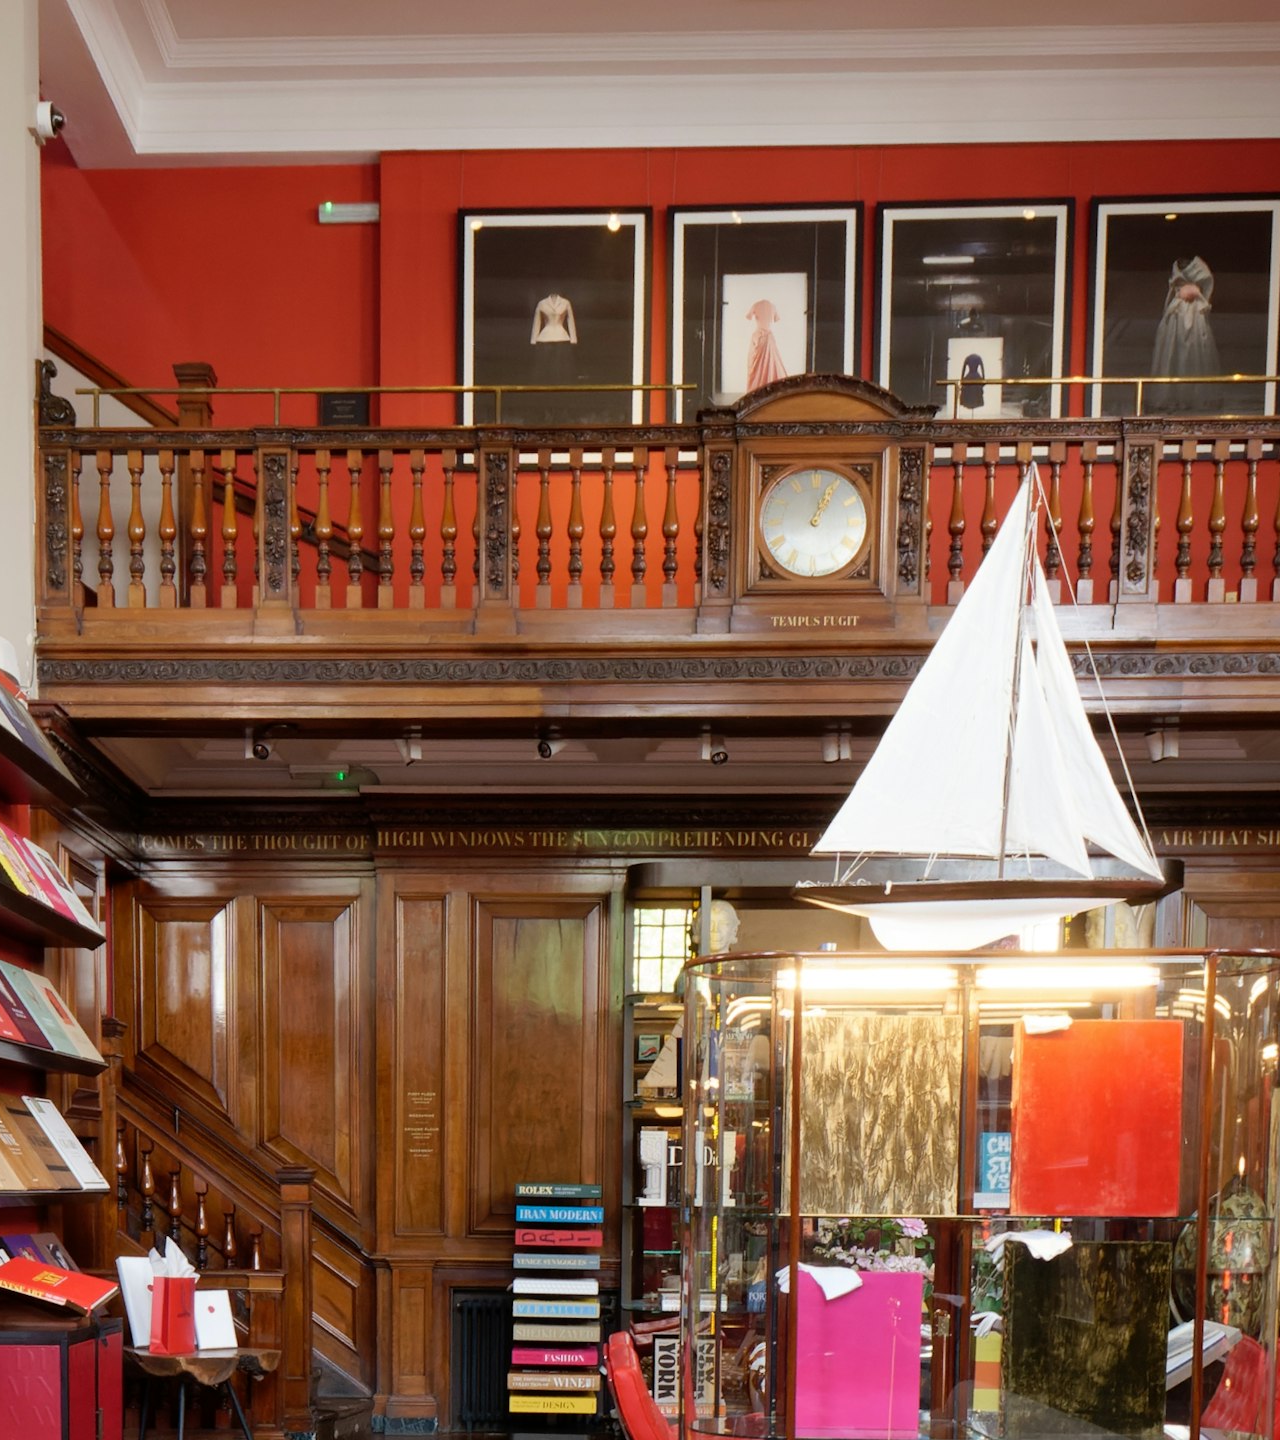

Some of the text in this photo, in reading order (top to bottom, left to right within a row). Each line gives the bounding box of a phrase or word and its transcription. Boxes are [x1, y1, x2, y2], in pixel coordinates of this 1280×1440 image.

[770, 615, 860, 628] TEMPUS FUGIT
[140, 834, 205, 851] COMES
[209, 834, 248, 851] THE
[250, 834, 343, 850] THOUGHT
[345, 834, 370, 850] OF
[376, 830, 425, 847] HIGH
[430, 830, 525, 847] WINDOWS
[528, 830, 568, 847] THE
[572, 830, 609, 847] SUN
[613, 830, 784, 848] COMPREHENDING
[1157, 830, 1194, 846] AIR
[1198, 830, 1252, 846] THAT
[518, 1185, 553, 1195] ROLEX
[519, 1208, 598, 1221] IRAN MODERN
[521, 1231, 591, 1244] DALI
[544, 1353, 585, 1363] FASHION
[657, 1342, 676, 1400] YORK
[552, 1376, 586, 1388] WINE
[542, 1401, 576, 1410] DESIGN
